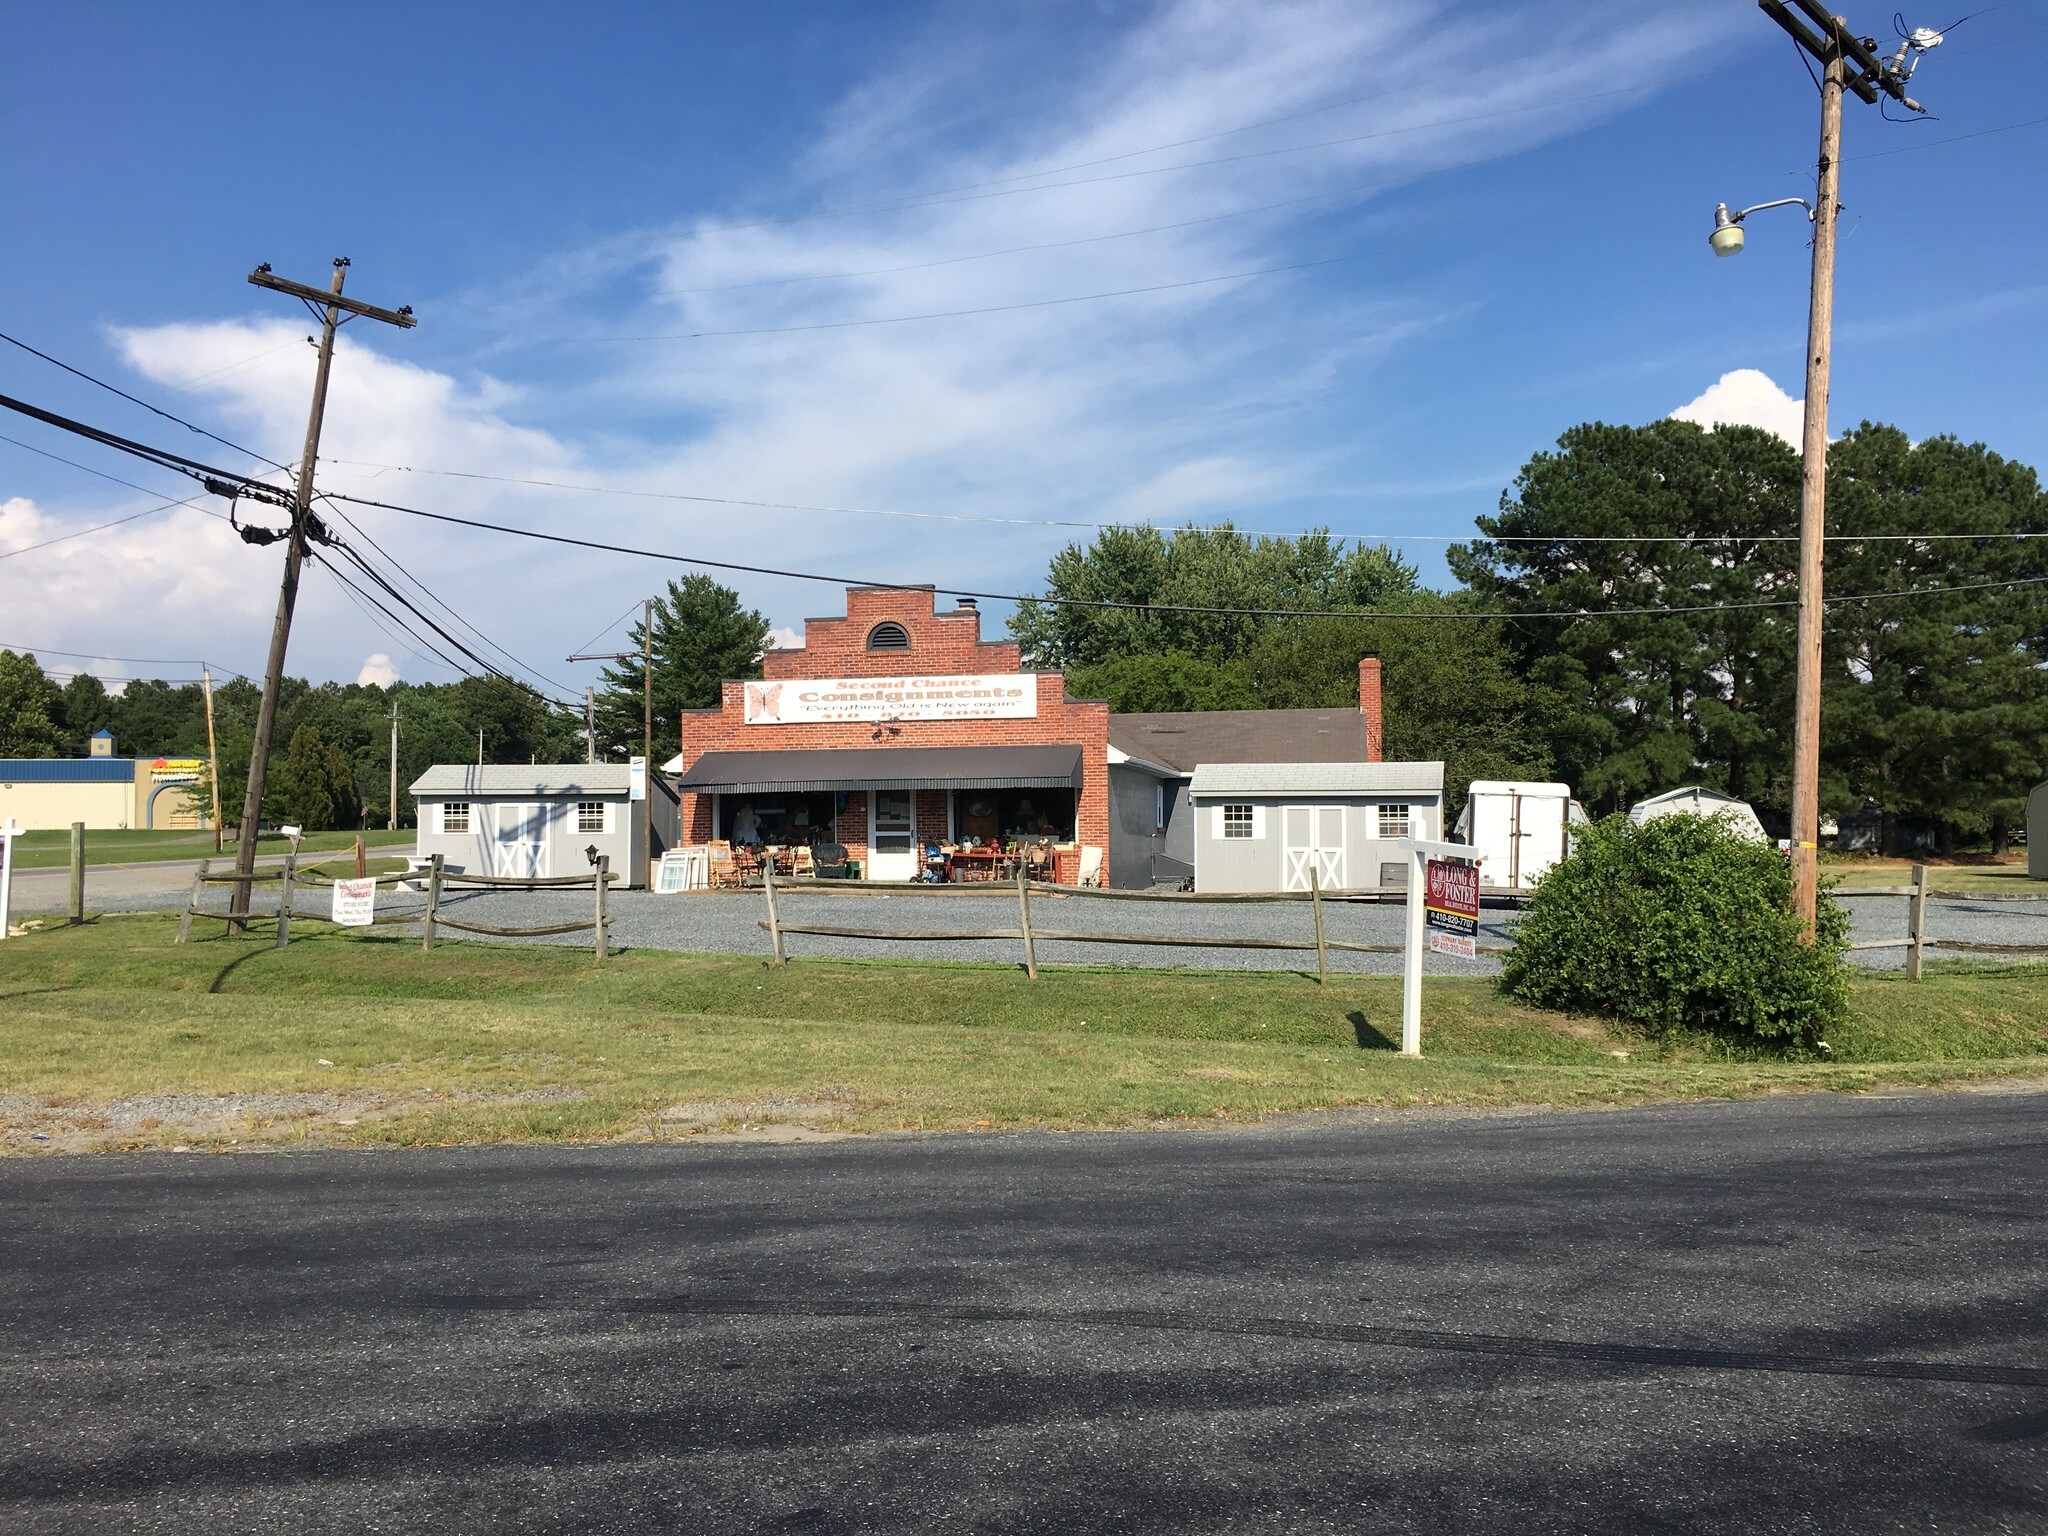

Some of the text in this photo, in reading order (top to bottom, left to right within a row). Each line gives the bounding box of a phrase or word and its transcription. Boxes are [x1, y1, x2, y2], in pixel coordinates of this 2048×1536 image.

[836, 679, 982, 690] Second Chance
[798, 687, 1023, 703] Consignments
[1445, 865, 1467, 886] LONG
[1469, 870, 1477, 887] &
[1444, 882, 1476, 905] FOSTER
[1435, 912, 1474, 928] 410-820-7707
